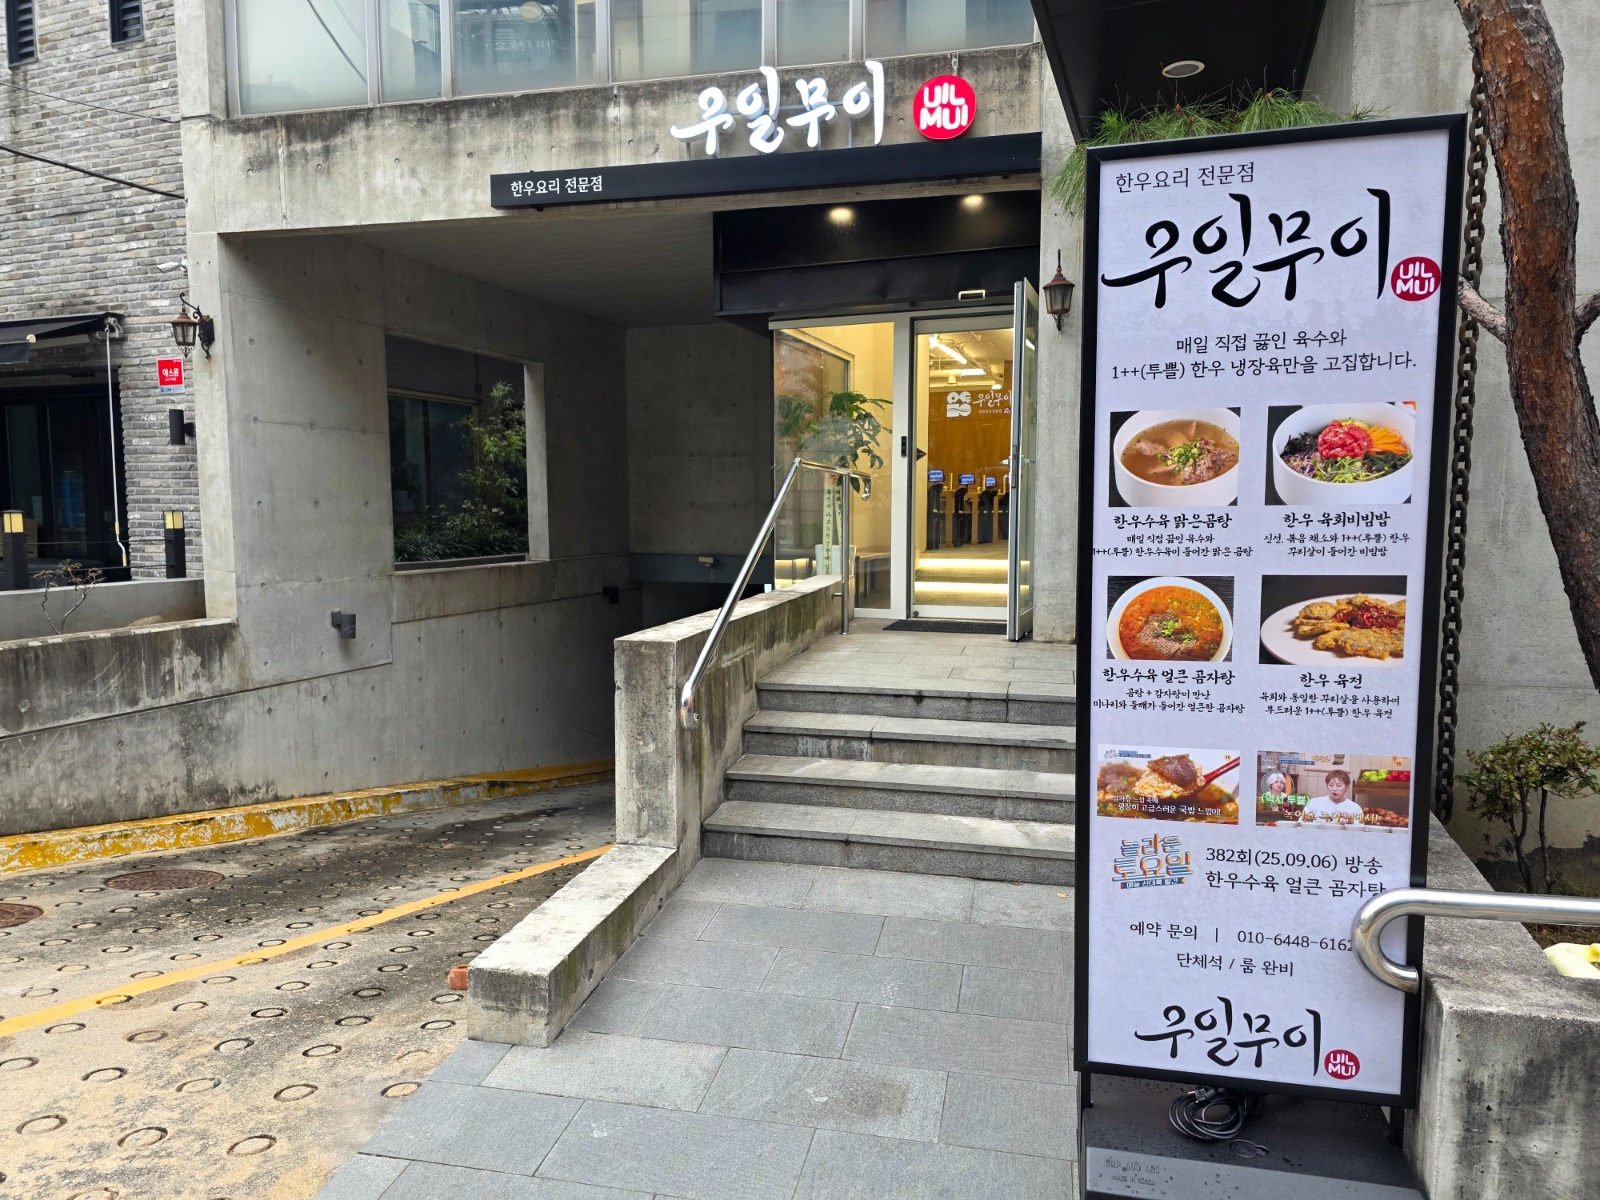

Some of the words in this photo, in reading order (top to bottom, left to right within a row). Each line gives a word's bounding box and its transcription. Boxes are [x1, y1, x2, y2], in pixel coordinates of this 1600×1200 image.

[924, 81, 966, 107] UIL
[671, 60, 884, 156] 우일무이
[919, 106, 969, 131] MUI
[510, 178, 560, 197] 한우요리
[564, 175, 603, 195] 전문점
[1115, 166, 1190, 193] 한우요리
[1197, 161, 1255, 186] 전문점
[1100, 187, 1391, 309] 우일무이
[1399, 263, 1432, 280] UIL
[1395, 278, 1435, 295] MUI
[1176, 335, 1209, 354] 매일
[1214, 333, 1247, 351] 직접
[1253, 332, 1287, 351] 끓인
[1292, 328, 1347, 347] 육수와
[1190, 359, 1225, 378] 한우
[1230, 356, 1318, 377] 냉장육만을
[1322, 350, 1417, 373] 고집합니다.
[972, 389, 1011, 407] 우일무이
[1113, 513, 1170, 529] 한우수육
[1174, 513, 1233, 529] 맑은곰탕
[1283, 512, 1313, 528] 한우
[1317, 511, 1391, 528] 육회비빔밥
[1127, 533, 1144, 544] 매일
[1146, 533, 1163, 544] 직접
[1165, 533, 1184, 544] 끓인
[1185, 533, 1215, 544] 육수와
[1286, 533, 1307, 544] 볶음
[1308, 533, 1339, 544] 채소와
[1389, 532, 1410, 544] 한우
[1135, 546, 1181, 557] 한우수육이
[1182, 546, 1210, 557] 들어간
[1212, 546, 1232, 557] 맑은
[1233, 546, 1254, 557] 곰탕
[1287, 546, 1325, 557] 꾸리살이
[1327, 546, 1358, 557] 들어간
[1359, 546, 1389, 557] 비빔밥
[1102, 666, 1158, 683] 한우수육
[1161, 668, 1188, 684] 얼큰
[1191, 669, 1236, 685] 곰자탕
[1299, 672, 1330, 688] 한우
[1333, 673, 1363, 689] 육전
[1125, 687, 1144, 698] 곰탕
[1154, 688, 1190, 699] 감자탕이
[1192, 689, 1211, 700] 만난
[1259, 692, 1287, 702] 육회와
[1320, 693, 1359, 705] 꾸리살을
[1361, 694, 1400, 706] 사용하여
[1093, 698, 1128, 709] 미나리와
[1129, 700, 1157, 711] 들깨가
[1158, 701, 1186, 712] 들어간
[1187, 702, 1215, 713] 얼큰한
[1216, 703, 1246, 714] 곰자탕
[1264, 705, 1303, 716] 부드러운
[1351, 707, 1371, 718] 한우
[1373, 708, 1393, 719] 육전
[1141, 804, 1177, 814] 고급스러운
[1179, 804, 1196, 815] 국밥
[1120, 833, 1182, 857] 놀라운
[1112, 851, 1193, 882] 토요일
[1344, 855, 1383, 875] 방송
[1205, 870, 1279, 893] 한우수육
[1286, 875, 1322, 896] 얼큰
[1328, 879, 1387, 899] 곰자탕
[1129, 921, 1162, 938] 예약
[1166, 923, 1198, 940] 문의
[1176, 952, 1223, 970] 단체석
[1239, 957, 1256, 975] 룸
[1261, 960, 1294, 977] 완비
[1134, 995, 1322, 1077] 우일무이
[1330, 1053, 1355, 1066] UIL
[1327, 1063, 1356, 1077] MUI
